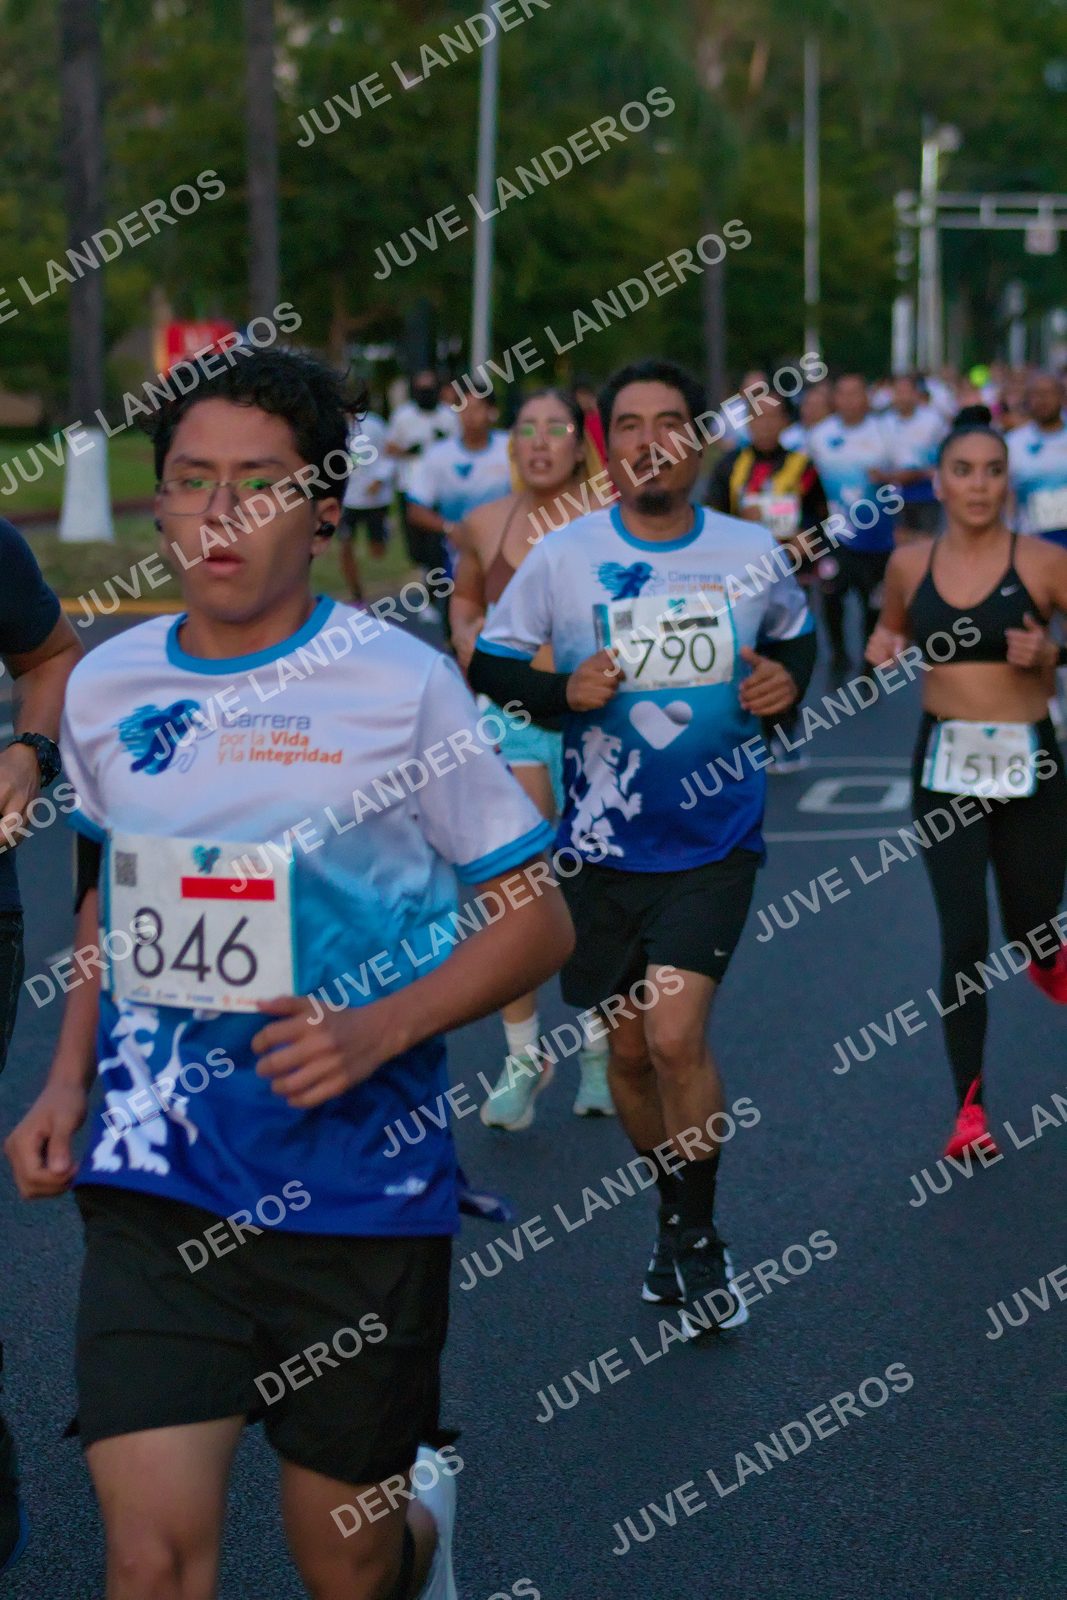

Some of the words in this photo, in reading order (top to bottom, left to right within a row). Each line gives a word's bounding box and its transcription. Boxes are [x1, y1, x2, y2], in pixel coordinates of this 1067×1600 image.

[630, 632, 716, 679] 790
[221, 711, 311, 730] Carrera
[219, 733, 245, 747] por
[251, 730, 265, 745] la
[271, 730, 309, 747] Vida
[249, 746, 343, 766] Integridad
[132, 906, 258, 986] 846
